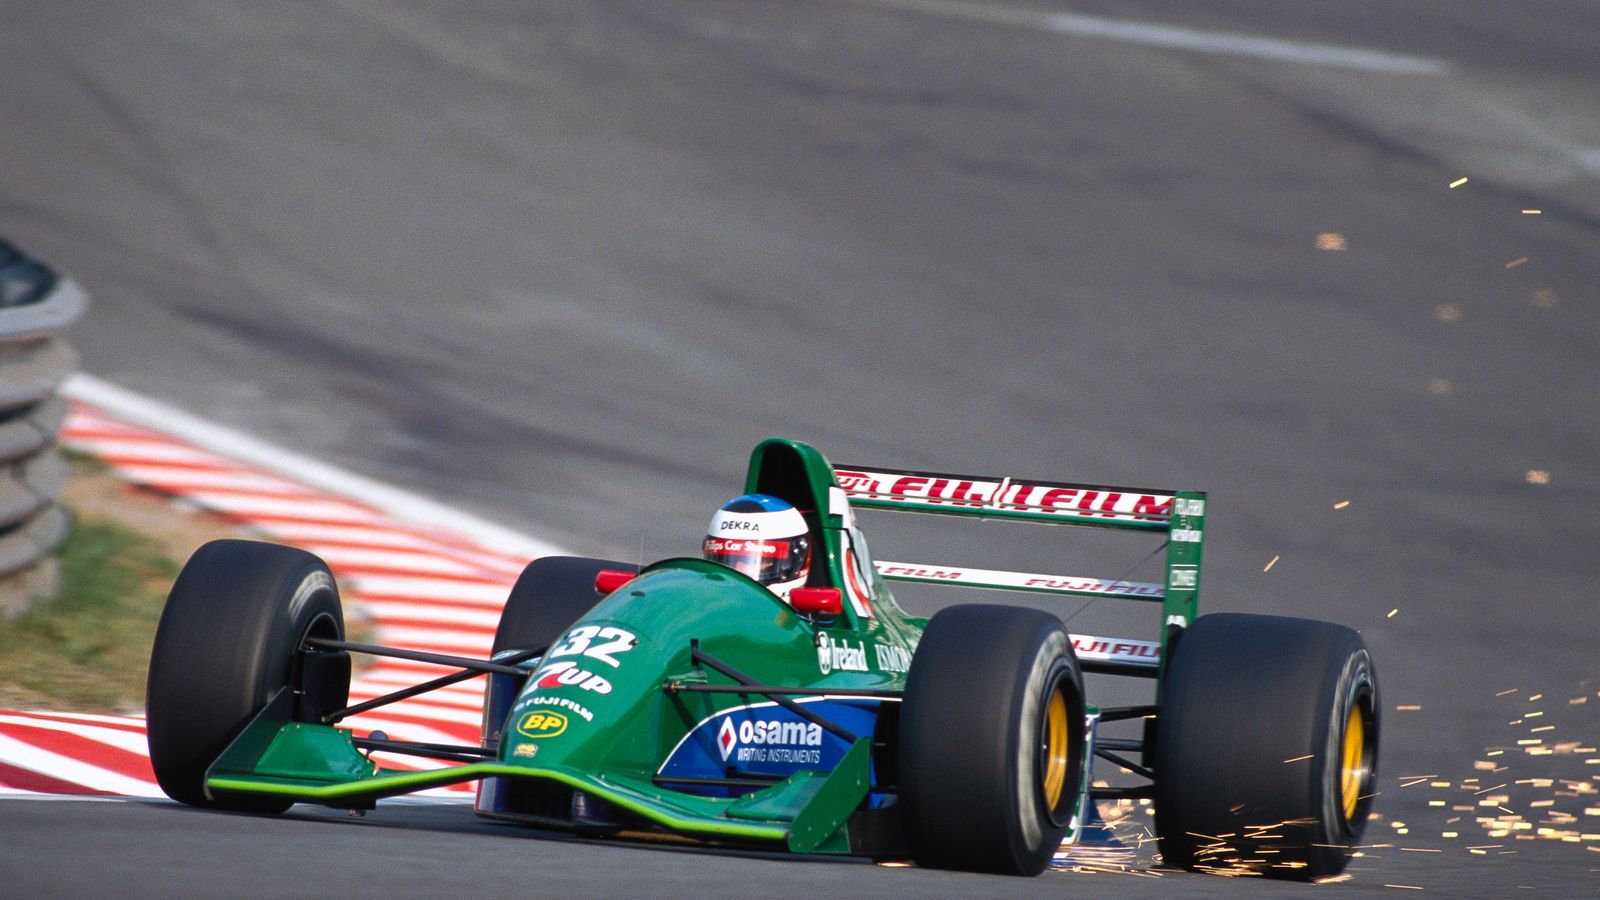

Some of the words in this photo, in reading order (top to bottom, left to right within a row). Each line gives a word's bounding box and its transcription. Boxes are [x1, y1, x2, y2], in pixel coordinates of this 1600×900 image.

[721, 520, 760, 532] DEKRA
[724, 540, 743, 551] Car
[549, 625, 636, 669] 32
[830, 637, 869, 671] Ireland
[523, 714, 562, 730] BP
[739, 719, 822, 746] osama
[737, 747, 767, 762] WRITING
[767, 748, 821, 764] INSTRUMENTS
